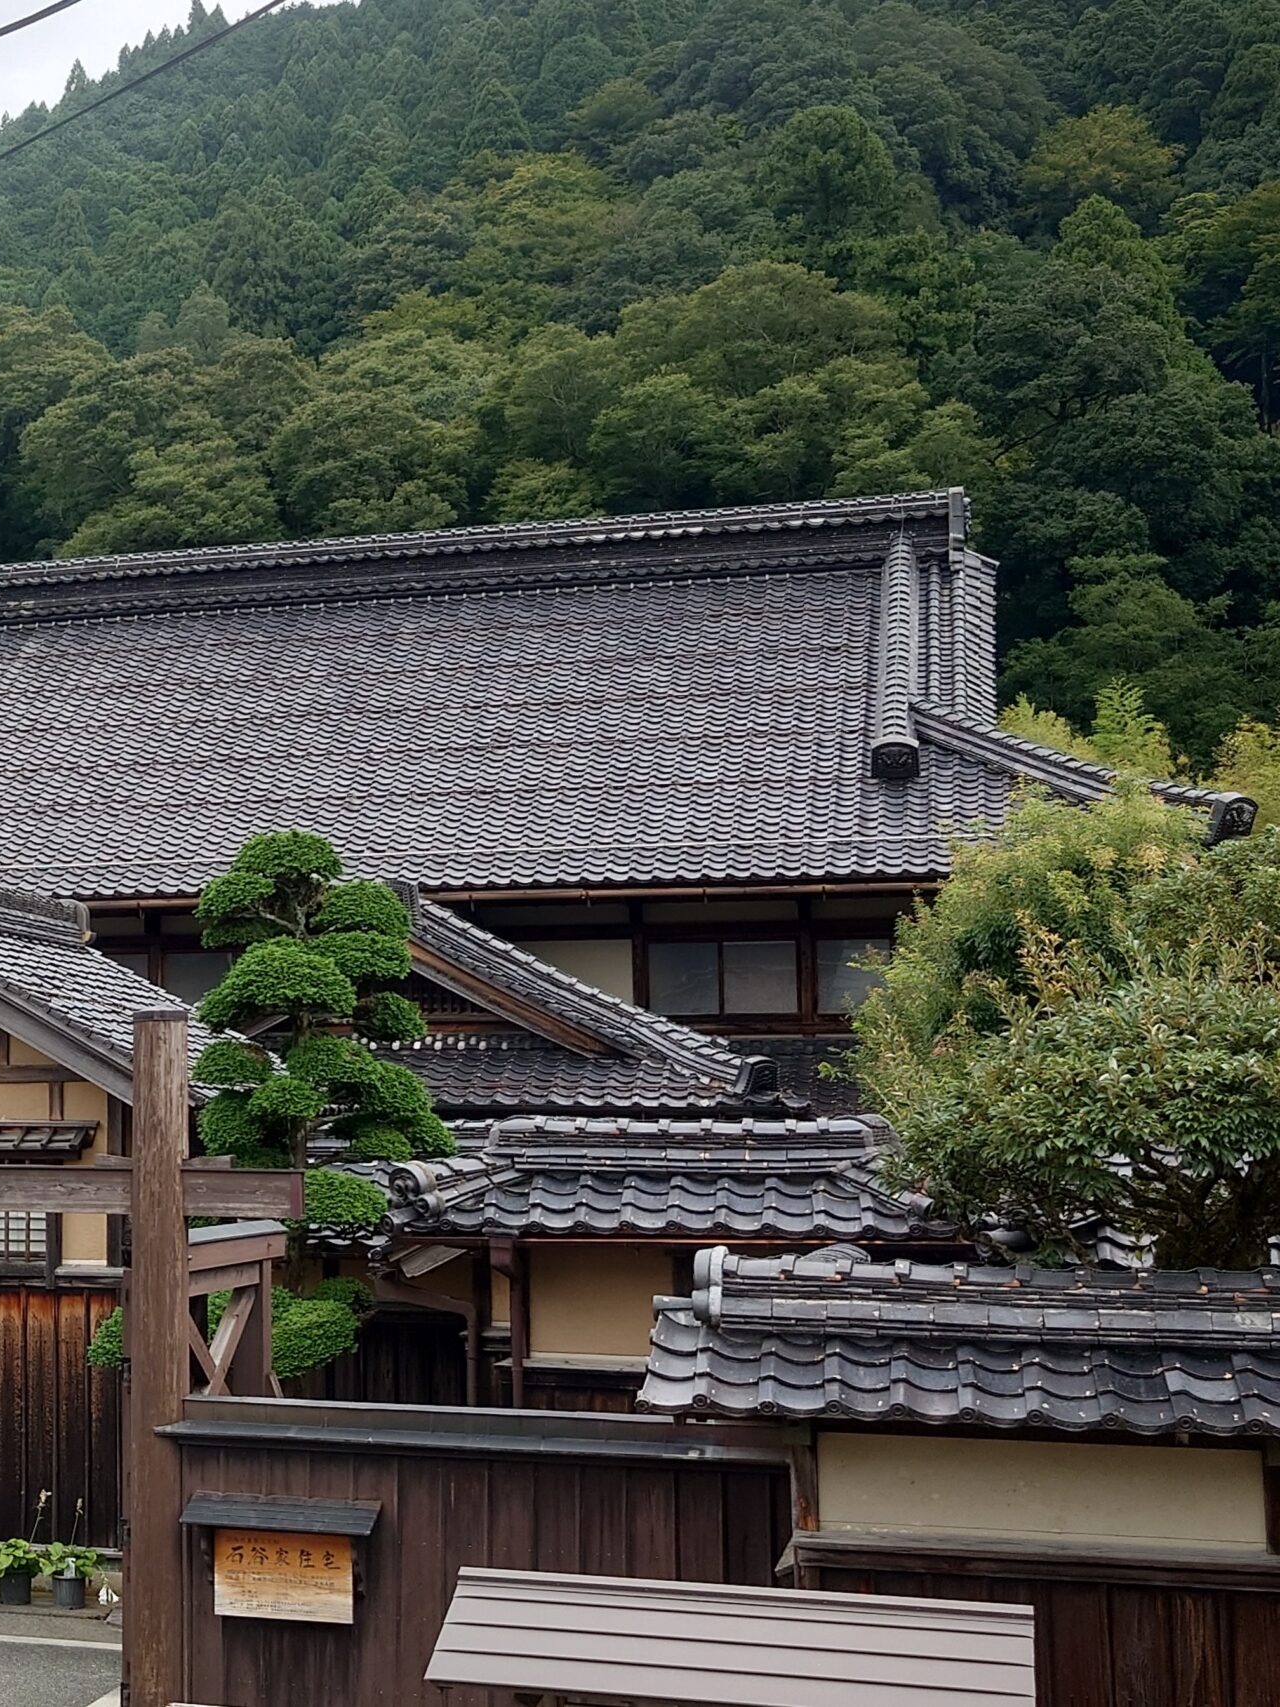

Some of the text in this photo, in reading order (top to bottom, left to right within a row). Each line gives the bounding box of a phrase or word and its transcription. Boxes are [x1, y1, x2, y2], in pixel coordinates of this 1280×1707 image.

[225, 1545, 341, 1570] 石谷家住宅
